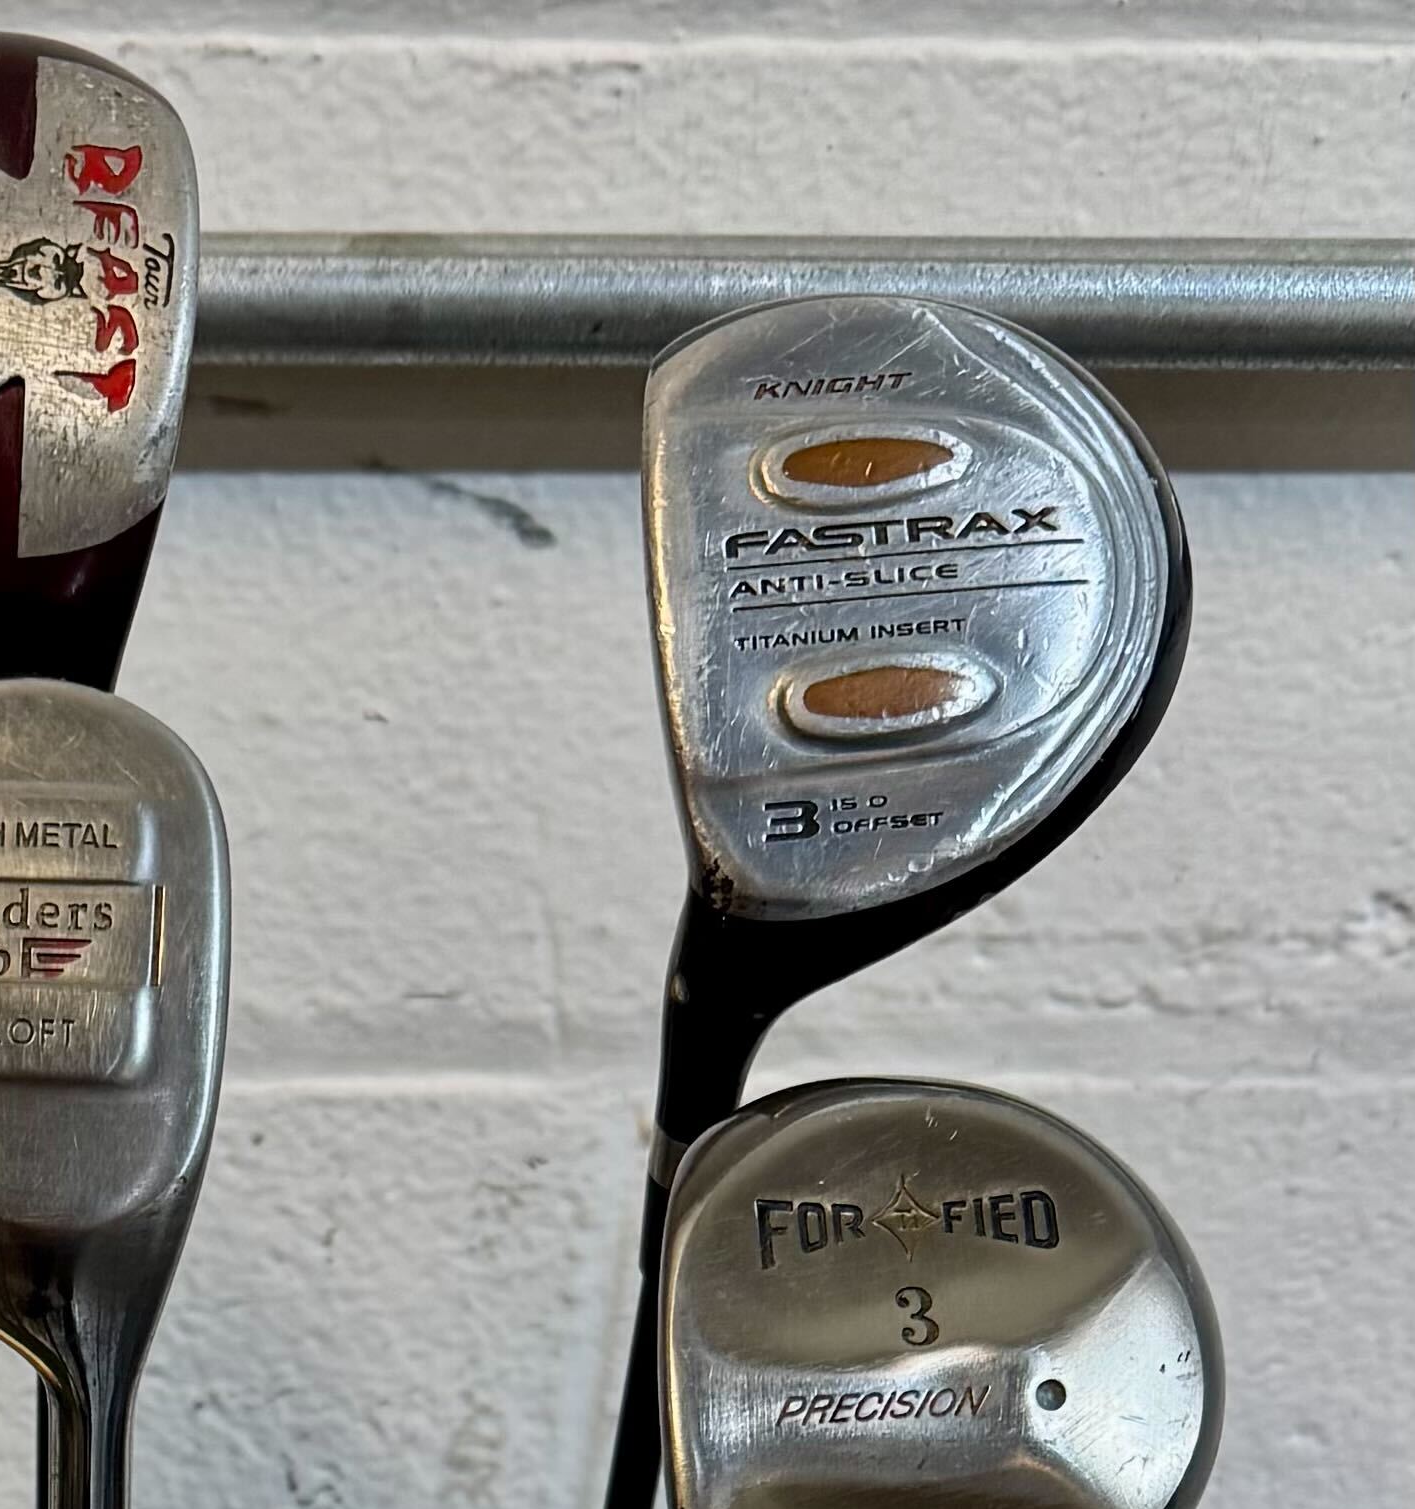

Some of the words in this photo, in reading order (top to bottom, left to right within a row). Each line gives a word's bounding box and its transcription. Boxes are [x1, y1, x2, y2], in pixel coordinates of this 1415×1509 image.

[754, 372, 912, 401] KNIGHT
[725, 506, 1058, 559] FASTRAX
[730, 563, 960, 599] ANTI-SLICE
[734, 626, 860, 651] TITANIUM
[869, 618, 967, 642] INSERT
[15, 822, 119, 850] METAL
[763, 800, 821, 843] 3
[833, 812, 944, 834] OFFSET
[895, 1286, 940, 1346] 3
[775, 1384, 991, 1427] PRECISION
